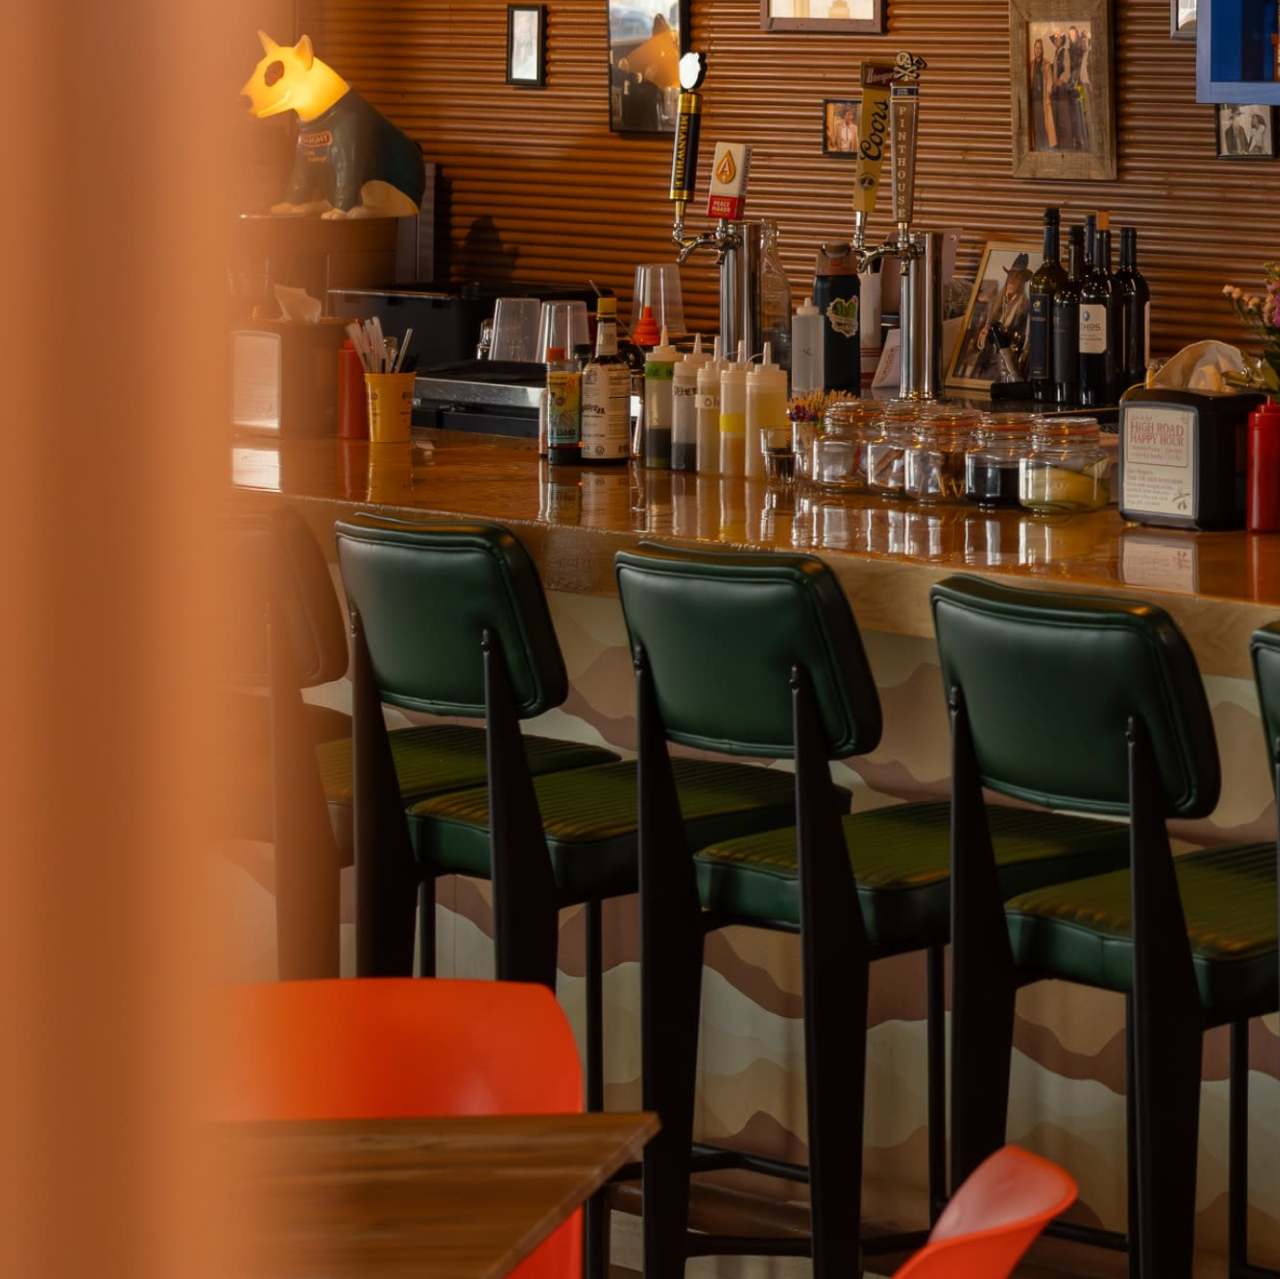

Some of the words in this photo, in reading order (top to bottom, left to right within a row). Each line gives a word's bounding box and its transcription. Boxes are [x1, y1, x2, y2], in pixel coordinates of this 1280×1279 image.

[675, 113, 690, 188] MEANWHILE
[860, 101, 889, 162] Coors
[898, 105, 907, 220] PINTHOUSE
[1130, 420, 1154, 434] HIGH
[1157, 422, 1184, 438] ROAD
